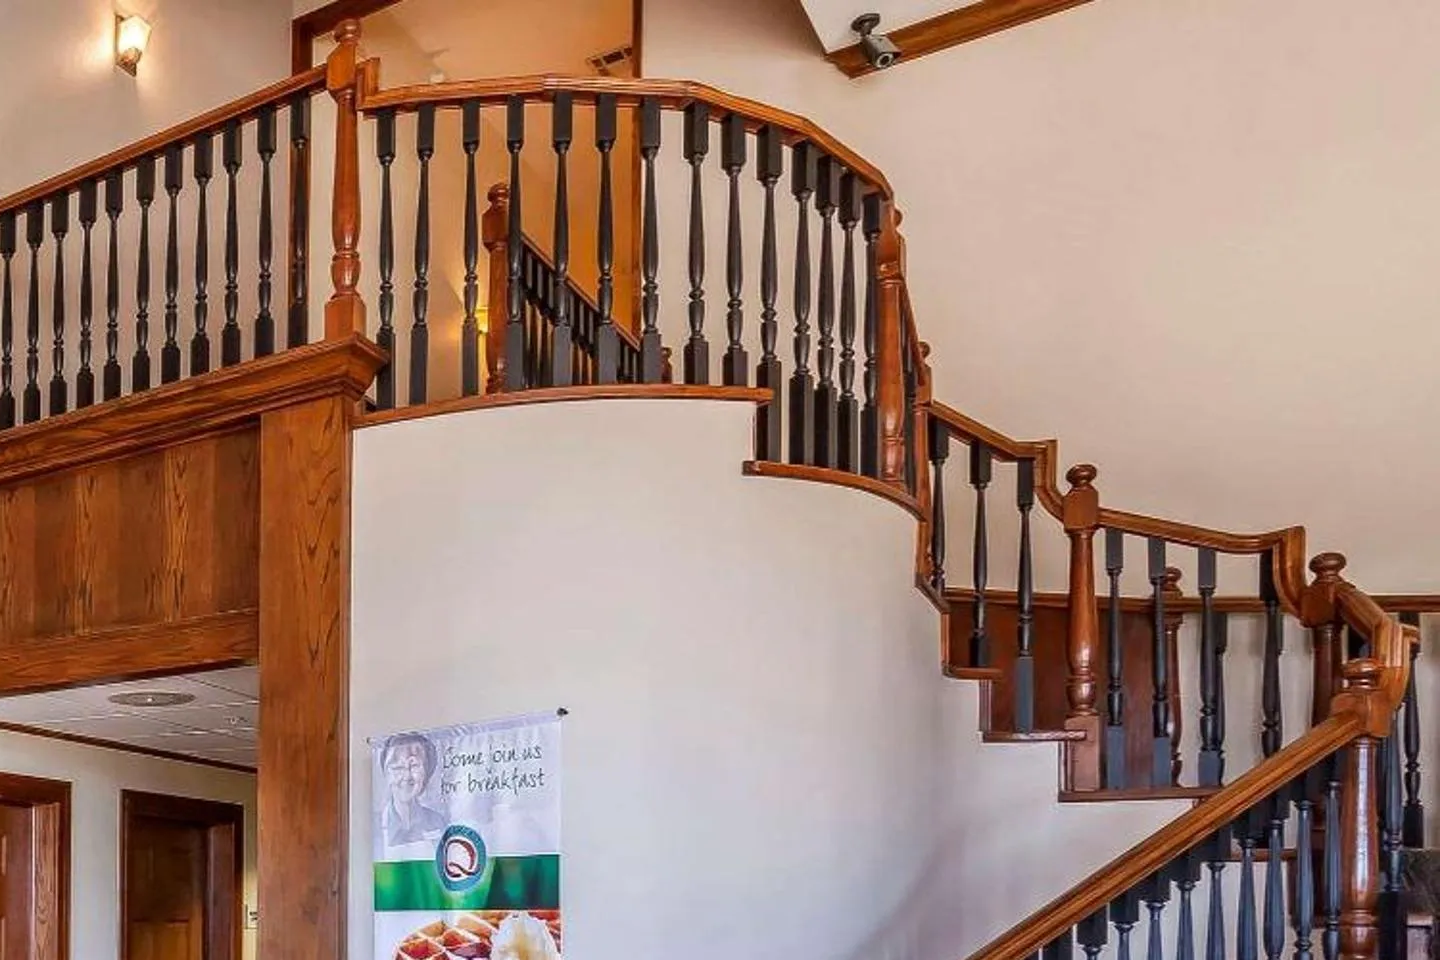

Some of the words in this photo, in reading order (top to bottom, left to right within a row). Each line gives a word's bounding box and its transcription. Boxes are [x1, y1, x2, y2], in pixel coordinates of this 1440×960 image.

[443, 746, 484, 769] Come
[521, 744, 542, 760] us
[467, 767, 545, 796] breakfast
